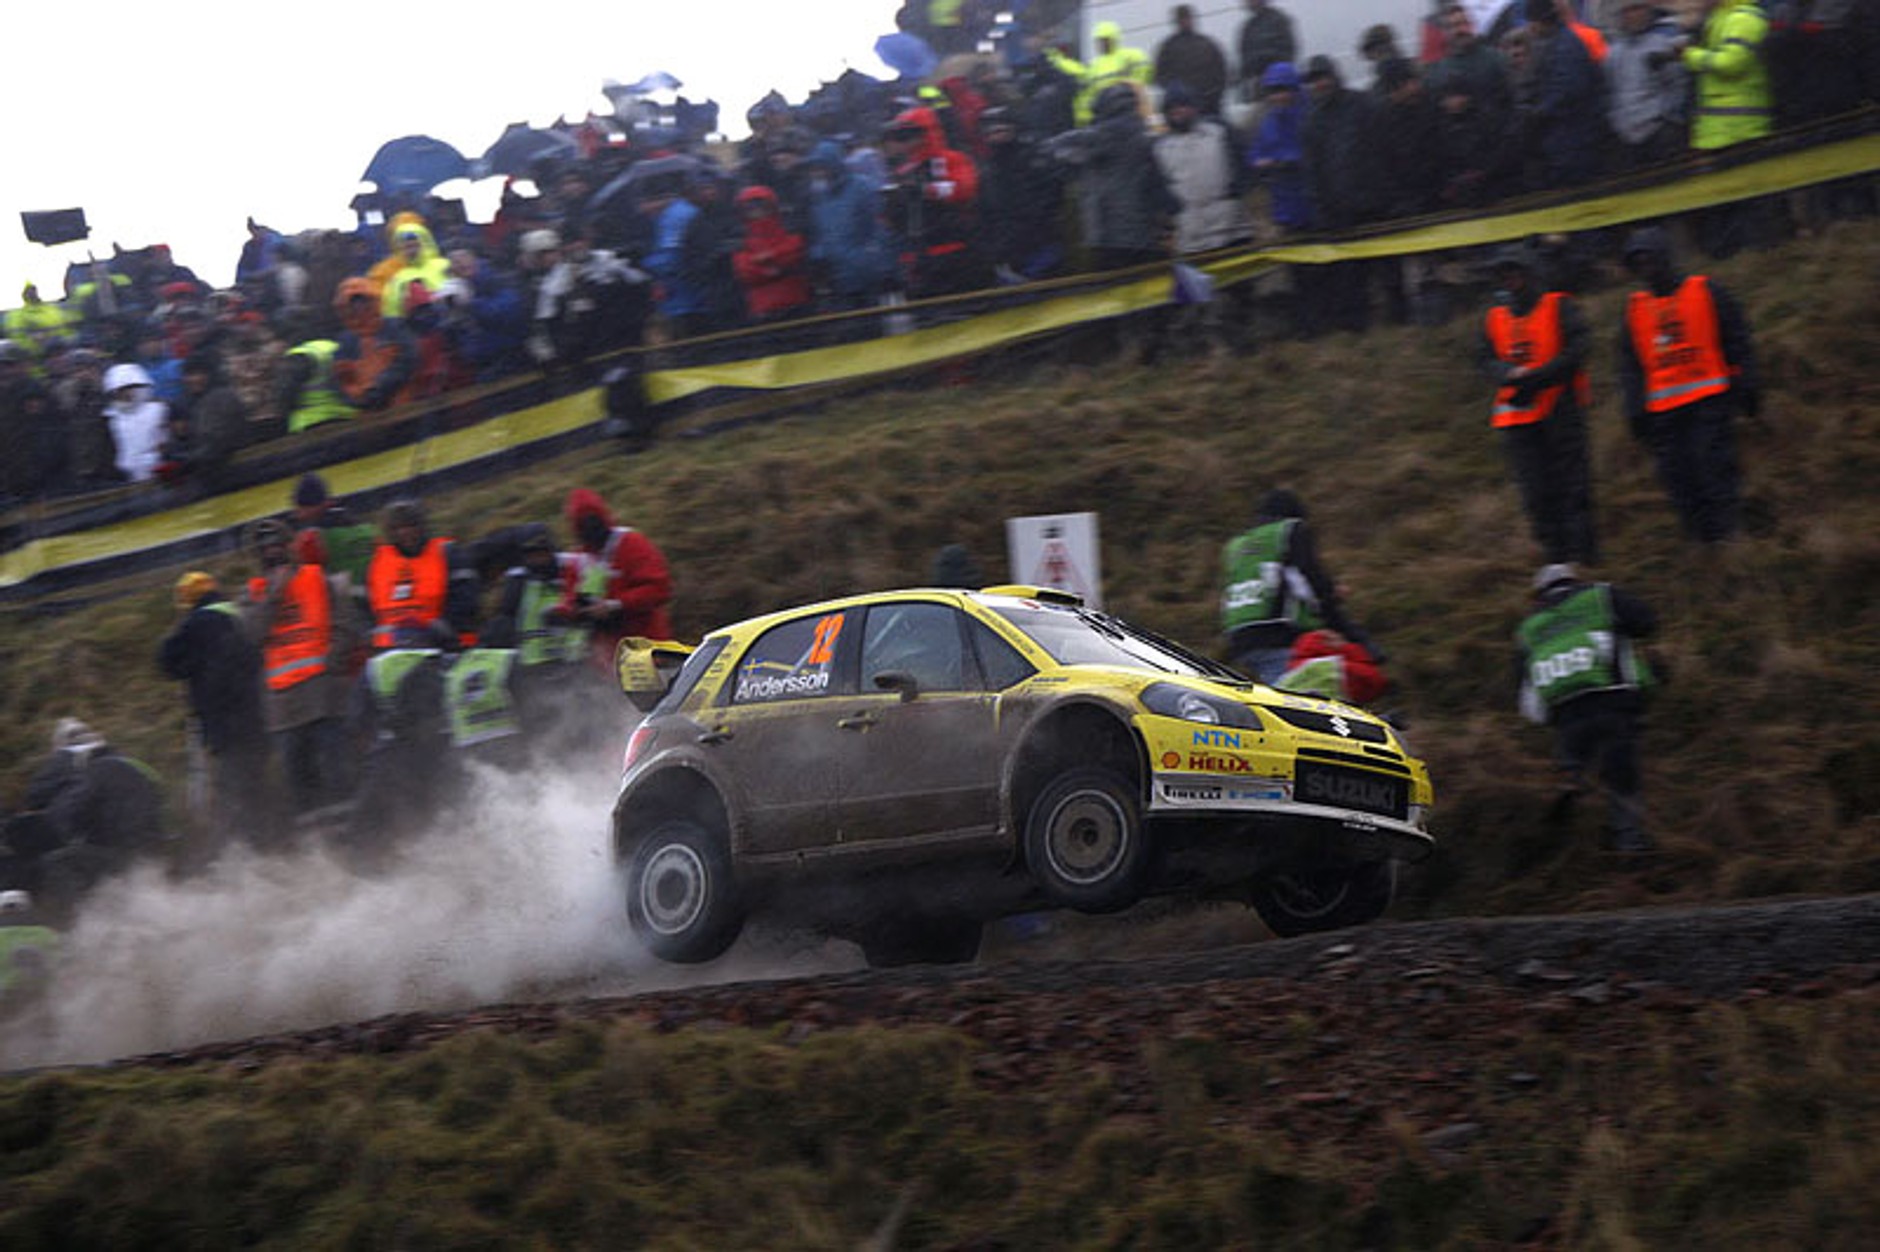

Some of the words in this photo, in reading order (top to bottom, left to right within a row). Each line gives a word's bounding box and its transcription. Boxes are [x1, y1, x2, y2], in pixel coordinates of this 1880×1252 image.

[808, 613, 845, 665] 12
[734, 672, 829, 700] Andersson
[1192, 730, 1241, 748] NTN
[1188, 756, 1251, 772] HELIX
[1163, 783, 1222, 800] PIRELLI
[1305, 770, 1397, 811] SUZUKI
